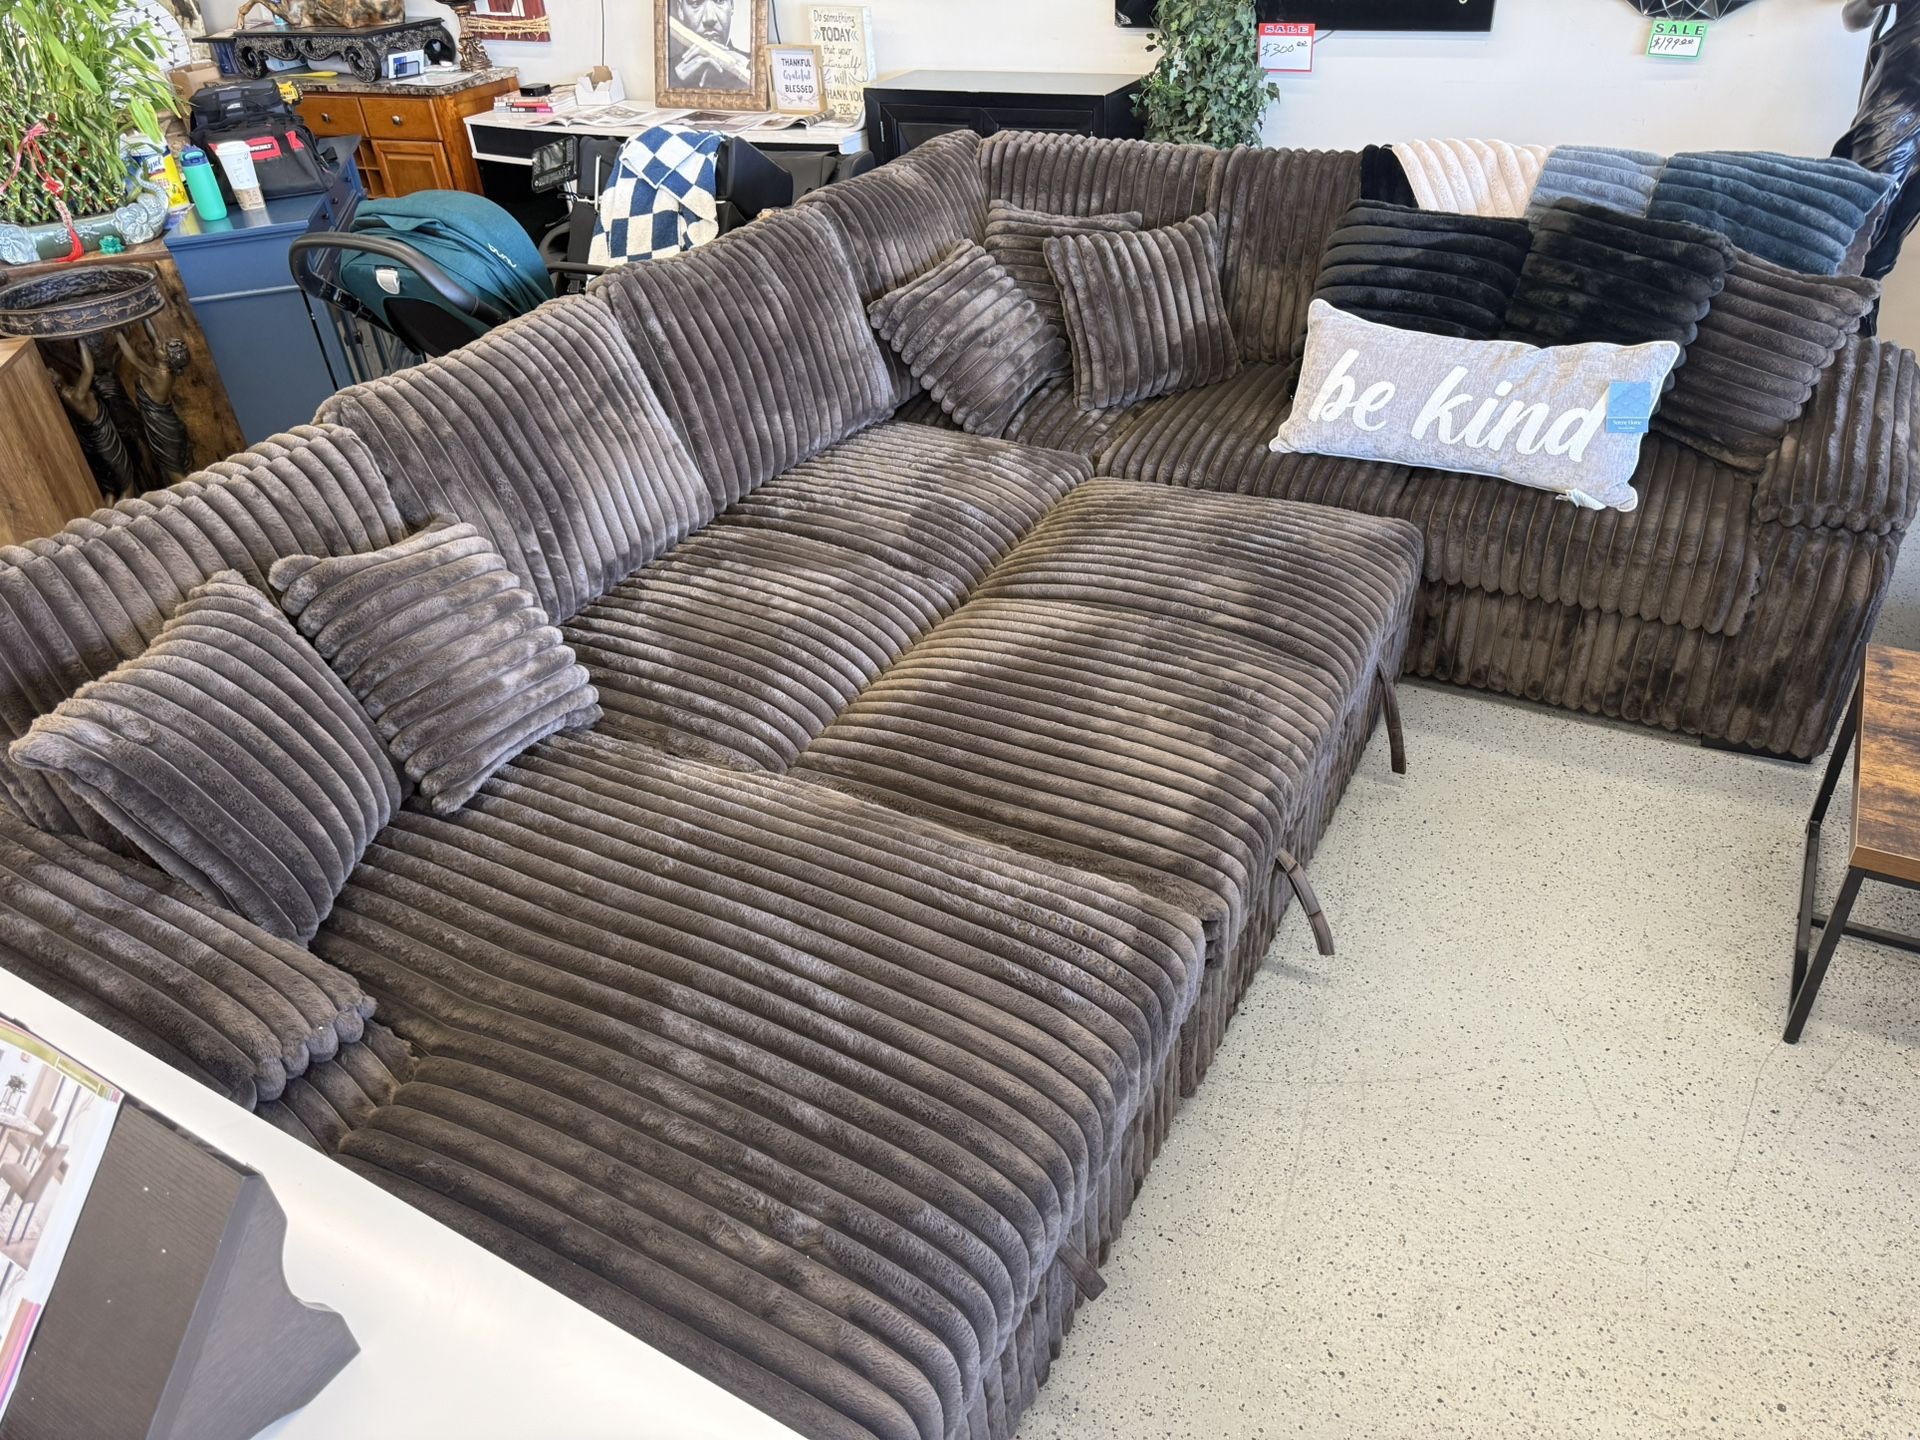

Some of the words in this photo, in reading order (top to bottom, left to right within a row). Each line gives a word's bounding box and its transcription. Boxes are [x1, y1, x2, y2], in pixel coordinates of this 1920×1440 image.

[813, 9, 823, 22] Do
[820, 27, 850, 41] TODAY
[1655, 23, 1704, 35] SALE
[781, 58, 811, 67] THANKFUL
[784, 85, 813, 93] BLESSED
[825, 88, 848, 101] HANK
[1308, 348, 1396, 432] be
[1410, 365, 1608, 463] kind
